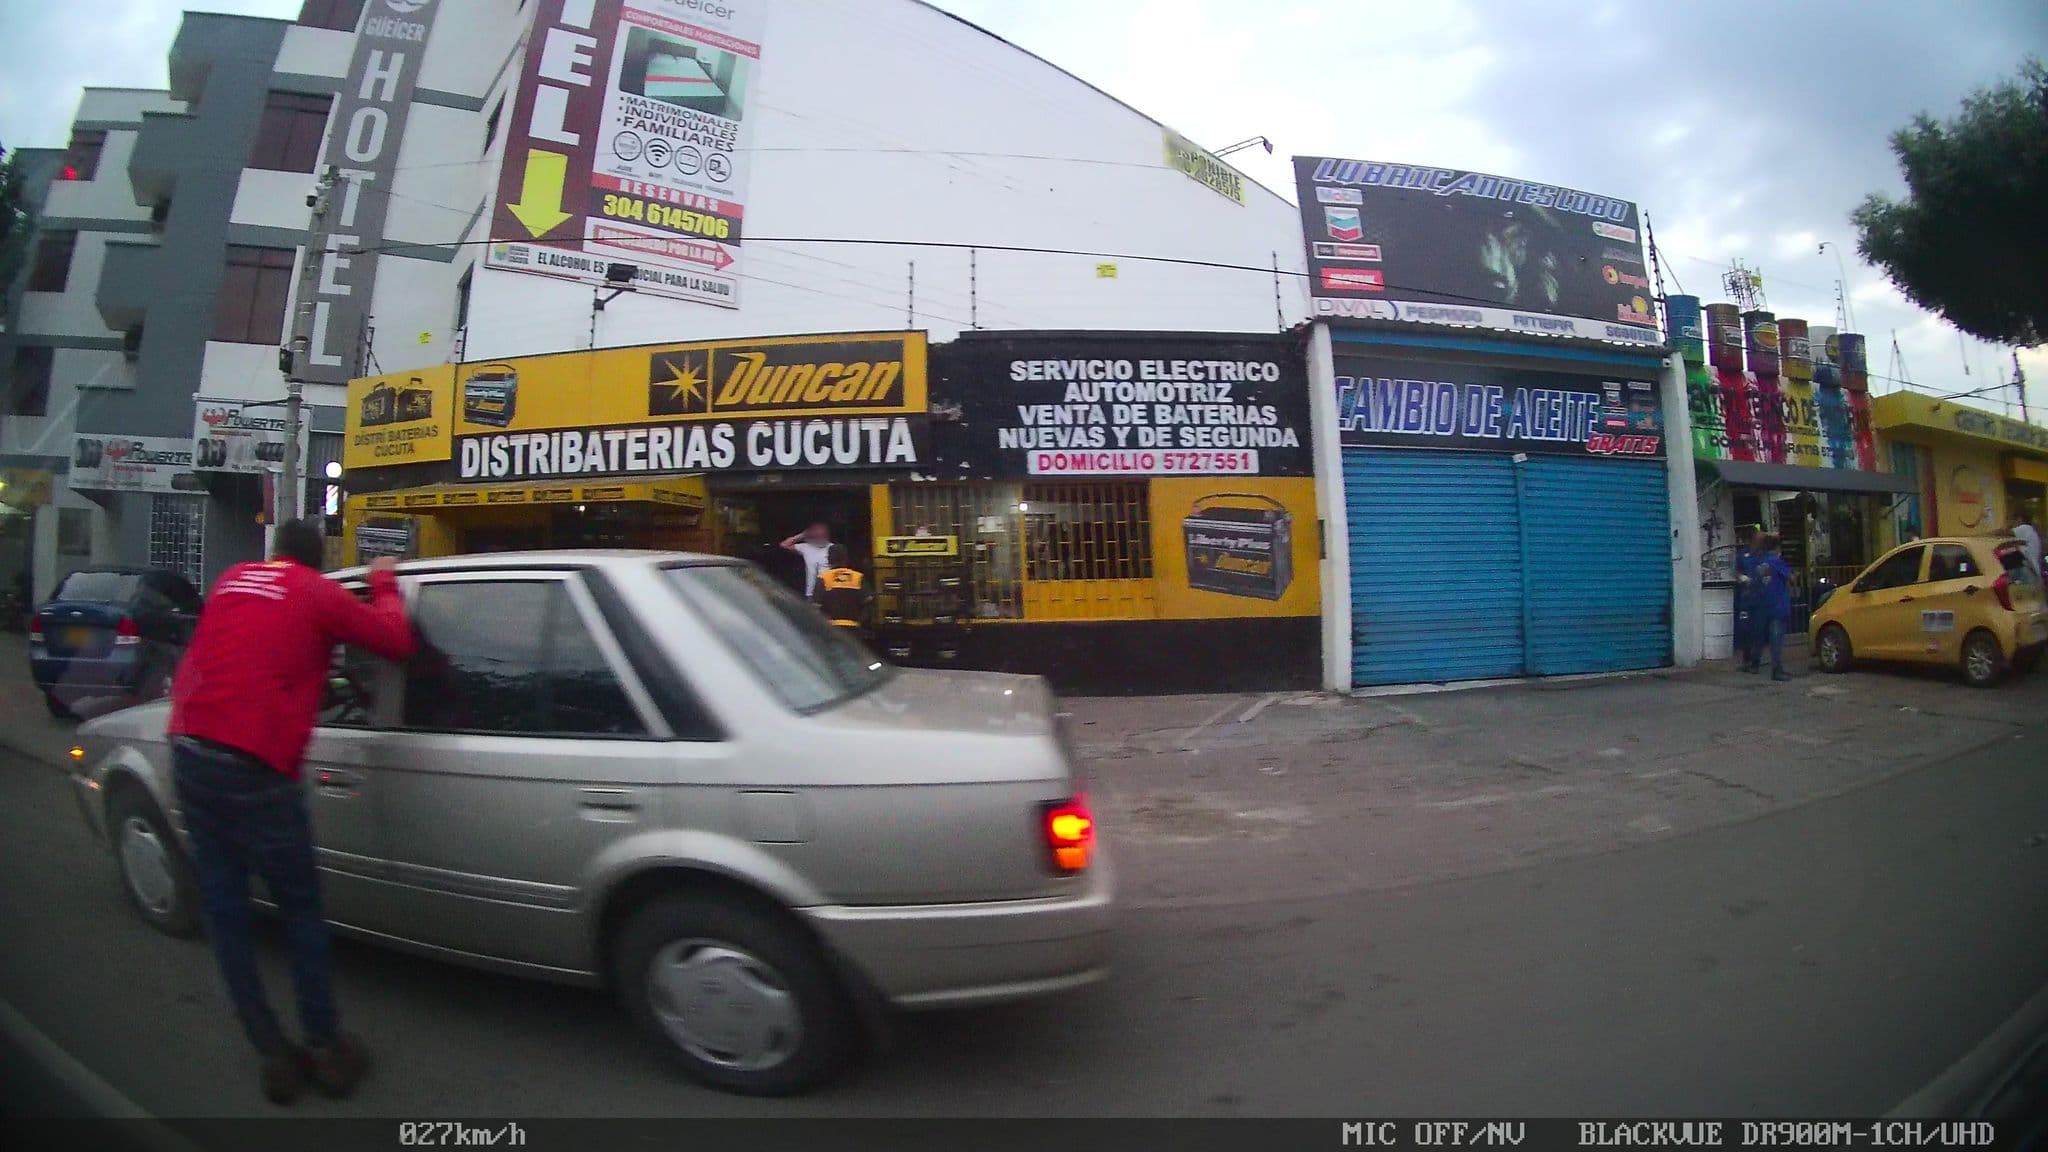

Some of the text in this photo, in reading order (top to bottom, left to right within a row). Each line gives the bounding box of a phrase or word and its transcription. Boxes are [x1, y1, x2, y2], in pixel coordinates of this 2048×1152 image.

[625, 107, 737, 142] INDIVIDUALES
[626, 97, 739, 132] MATRIMONIALES
[623, 117, 735, 153] FAMILIARES
[308, 50, 405, 367] HOTEL
[619, 179, 719, 211] RESERVAS
[603, 194, 729, 238] 304 6145706
[548, 255, 591, 273] ALCOHOL
[593, 263, 605, 274] ES
[665, 273, 688, 286] PARA
[715, 352, 902, 406] Duncan
[1010, 360, 1279, 382] SERVICIO ELECTRICO
[1063, 382, 1233, 403] AUTOMOTRIZ
[1018, 405, 1278, 425] VENTA DE BATERIAS
[1462, 384, 1503, 438] DE
[1507, 387, 1600, 442] ACEITE
[388, 424, 438, 442] BATERIAS
[460, 417, 918, 478] DISTRIBATERIAS CUCUTA
[998, 427, 1299, 449] NUEVAS Y DE SEGUNDA
[1586, 432, 1660, 455] GRATIS
[374, 441, 416, 458] CUCUTA
[1039, 453, 1250, 471] DOMICILIO 5727551
